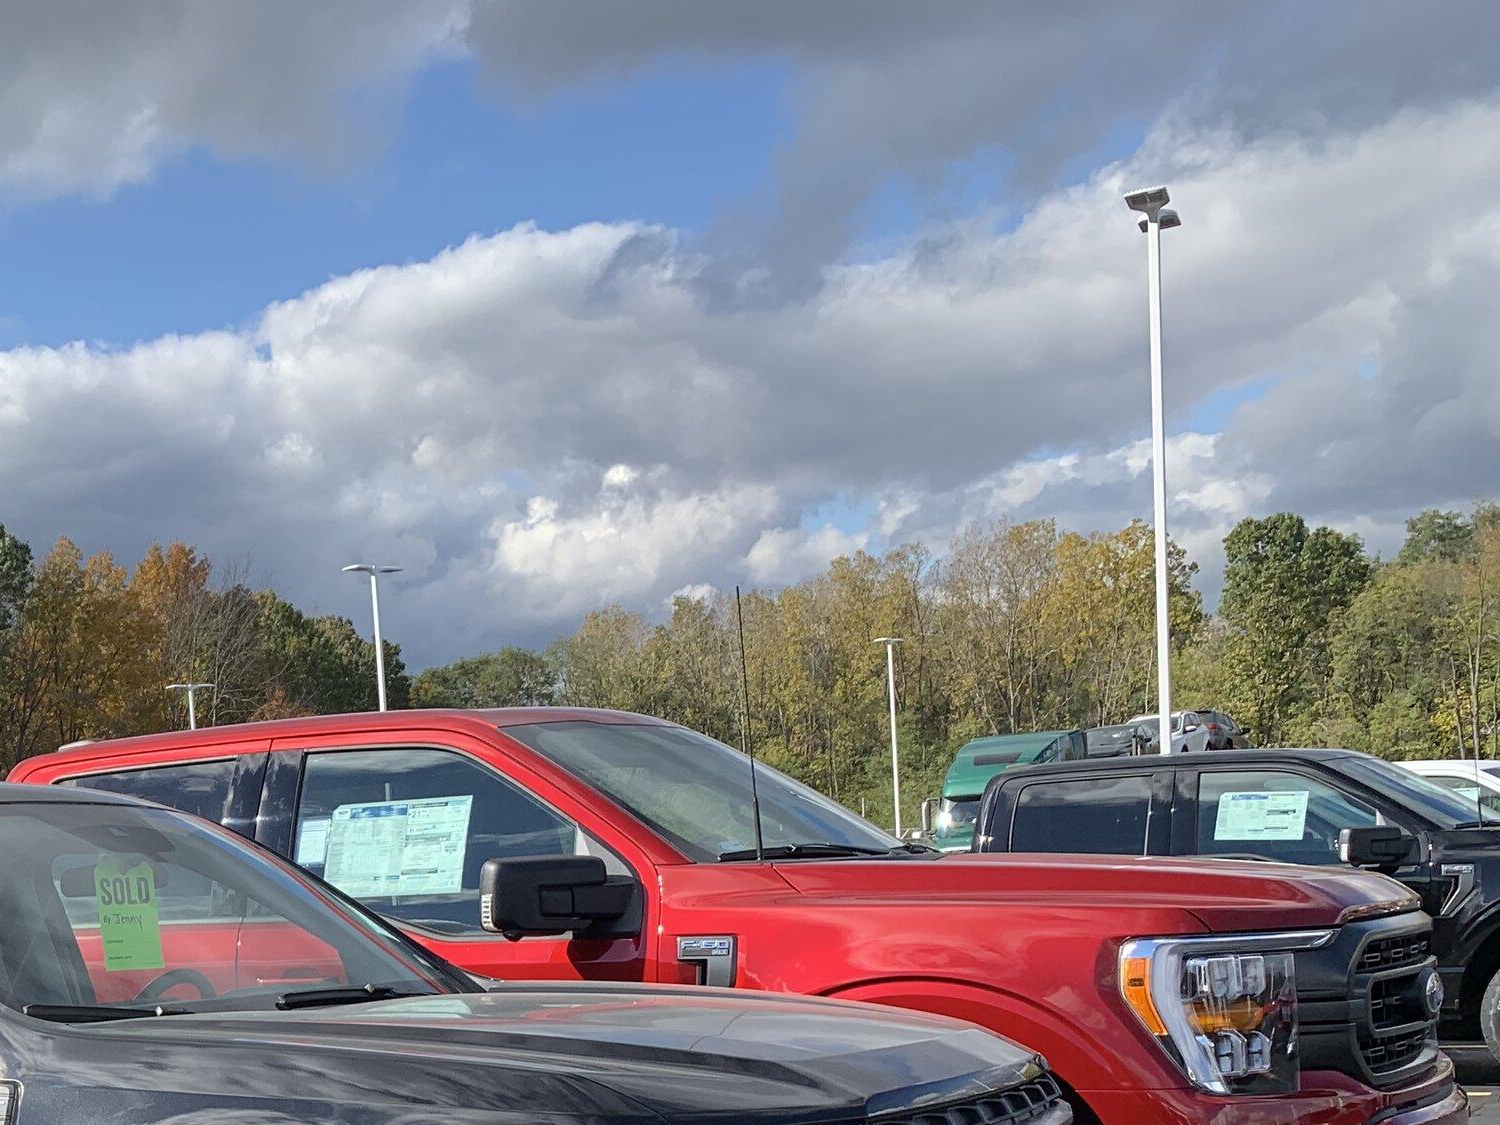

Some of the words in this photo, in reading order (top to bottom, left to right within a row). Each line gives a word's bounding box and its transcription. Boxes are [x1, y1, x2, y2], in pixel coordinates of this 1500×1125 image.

[99, 877, 150, 906] SOLD
[103, 915, 111, 924] By
[113, 912, 143, 930] Jenny
